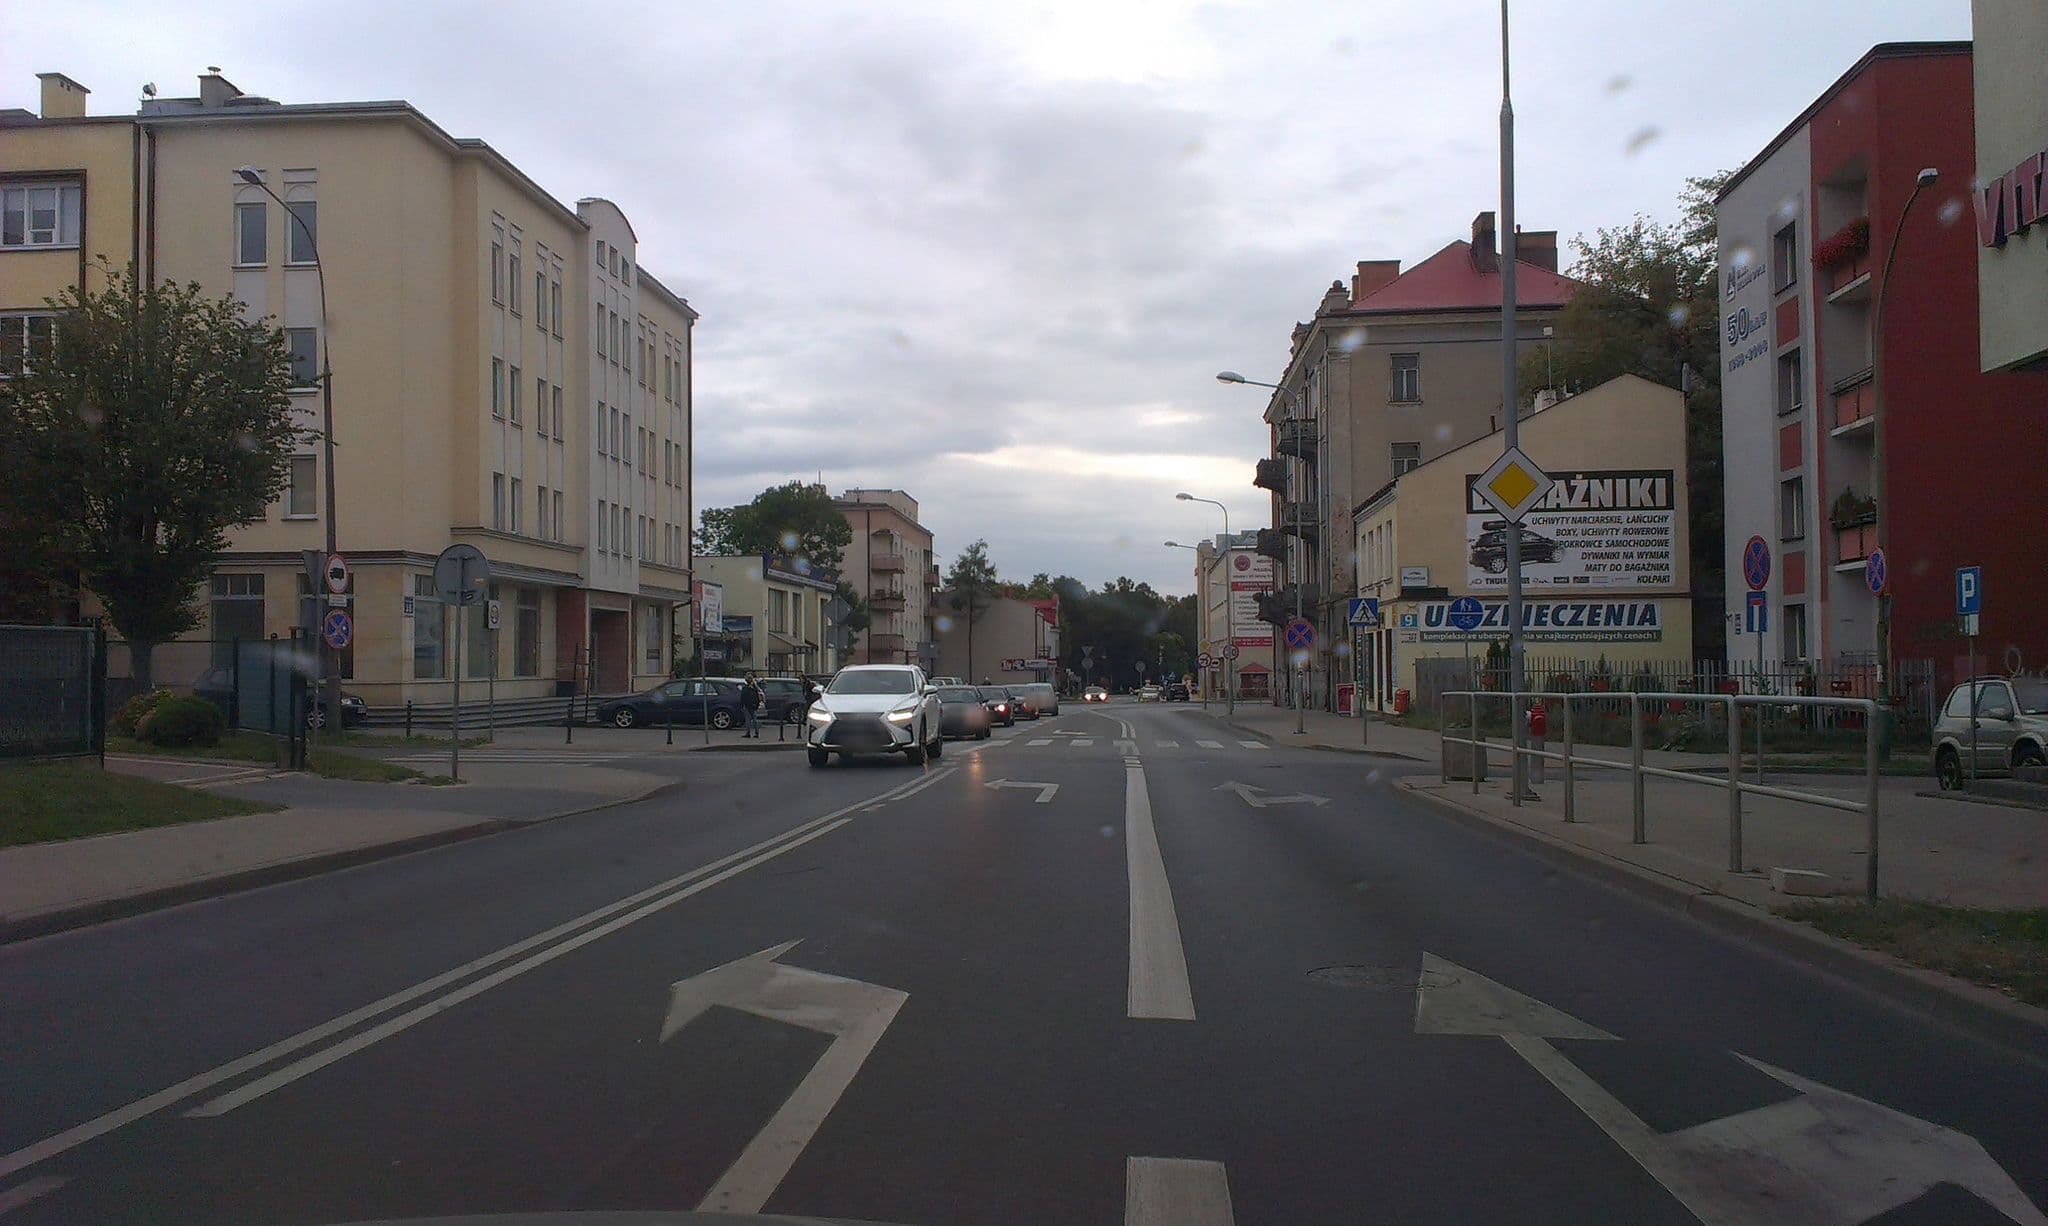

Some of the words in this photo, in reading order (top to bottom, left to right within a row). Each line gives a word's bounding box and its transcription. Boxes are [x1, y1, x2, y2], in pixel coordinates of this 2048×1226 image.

[1972, 148, 2048, 247] VIT
[1728, 307, 1749, 346] 50
[1531, 515, 1570, 525] UCHWYTY
[1626, 513, 1670, 524] ŁAŃCUCHY
[1581, 527, 1619, 536] UCHWYTY
[1622, 526, 1670, 536] ROWEROWE
[1559, 540, 1603, 548] POKROWCE
[1605, 538, 1670, 548] SAMOCHODOWE
[1581, 551, 1621, 560] DYWANIKI
[1622, 551, 1634, 560] NA
[1637, 551, 1670, 560] WYMIAR
[1584, 563, 1607, 572] MATY
[1609, 563, 1622, 571] DO
[1624, 561, 1670, 571] BAGAŻNIKA
[1962, 573, 1975, 607] P
[1535, 633, 1543, 641] w
